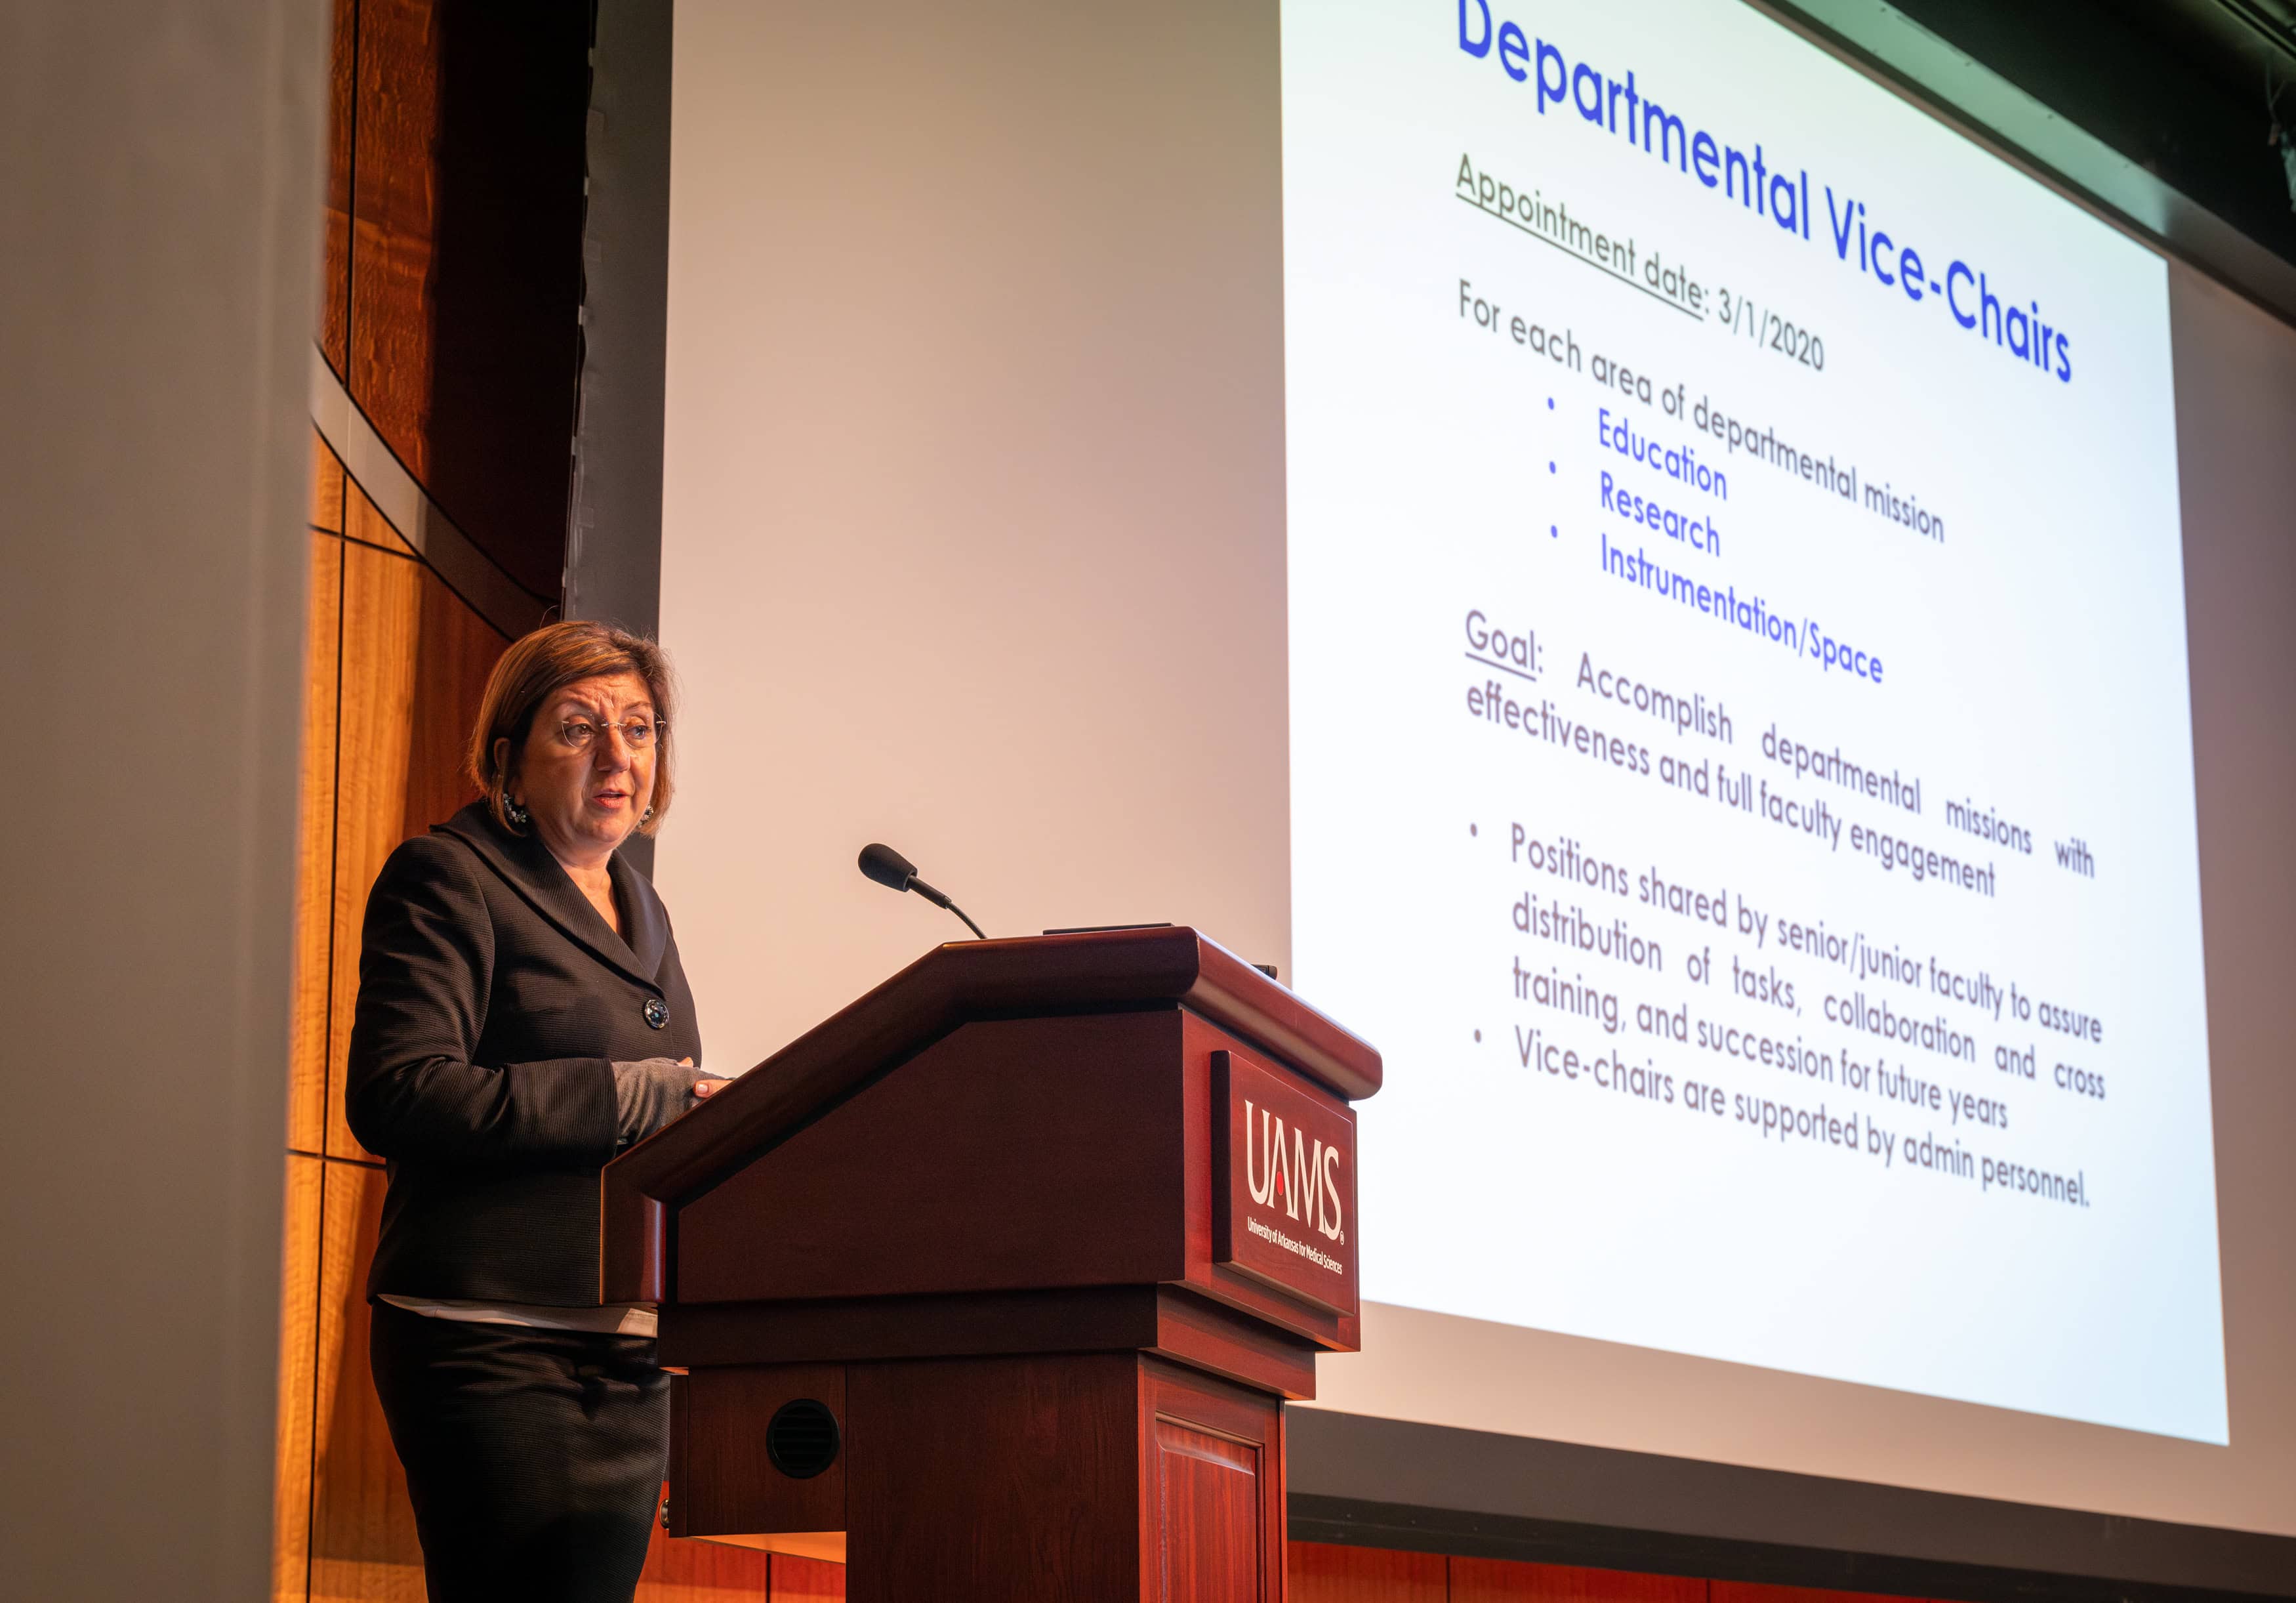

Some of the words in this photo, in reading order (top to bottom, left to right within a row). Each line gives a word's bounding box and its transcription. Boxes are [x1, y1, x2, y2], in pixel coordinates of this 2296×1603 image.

[1456, 152, 1635, 277] Appointment
[1644, 251, 1710, 316] date:
[1717, 287, 1824, 372] 3/1/2020
[1458, 0, 1809, 240] Departmental
[1825, 184, 2072, 383] Vice-Chairs
[1458, 278, 1501, 335] For
[1510, 310, 1581, 372] each
[1591, 348, 1652, 405] area
[1662, 383, 1684, 420] of
[1693, 395, 1856, 502] departmental
[1864, 482, 1944, 543] mission
[1598, 407, 1727, 501] Education
[1600, 470, 1720, 557] Research
[1601, 533, 1883, 683] Instrumentation/Space
[1466, 610, 1543, 674] Goal:
[1577, 652, 1732, 744] Accomplish
[1762, 722, 1921, 814] departmental
[1946, 797, 2032, 855] missions
[2055, 837, 2094, 879] with
[1467, 680, 1649, 776] effectiveness
[1660, 755, 1708, 797] and
[1718, 764, 1752, 812] full
[1761, 780, 1841, 852] faculty
[1851, 823, 1995, 898] engagement
[1511, 822, 1628, 896] Positions
[1639, 865, 1727, 928] shared
[1738, 894, 1767, 949] by
[1778, 920, 1922, 987] senior/junior
[1929, 956, 2003, 1021] faculty
[2011, 982, 2030, 1021] to
[2039, 1001, 2102, 1043] assure
[1513, 892, 1662, 972] distribution
[1687, 946, 1710, 986] of
[1732, 955, 1801, 1017] tasks,
[1824, 991, 1975, 1062] collaboration
[1994, 1044, 2036, 1079] and
[2055, 1062, 2105, 1100] cross
[1513, 955, 1626, 1034] training,
[1637, 1003, 1688, 1043] and
[1697, 1019, 1833, 1083] succession
[1841, 1049, 1870, 1092] for
[1878, 1058, 1941, 1111] future
[1949, 1087, 2008, 1129] years
[1515, 1024, 1674, 1104] Vice-chairs
[1684, 1080, 1725, 1115] are
[1734, 1093, 1858, 1150] supported
[1867, 1115, 1895, 1168] by
[1904, 1131, 1975, 1180] admin
[1982, 1155, 2089, 1208] personnel.
[1245, 1100, 1342, 1240] UAMS
[1248, 1216, 1272, 1243] University
[1272, 1230, 1278, 1243] of
[1278, 1231, 1299, 1255] Arkansas
[1306, 1245, 1323, 1266] Medical
[1323, 1251, 1342, 1275] Sciences
